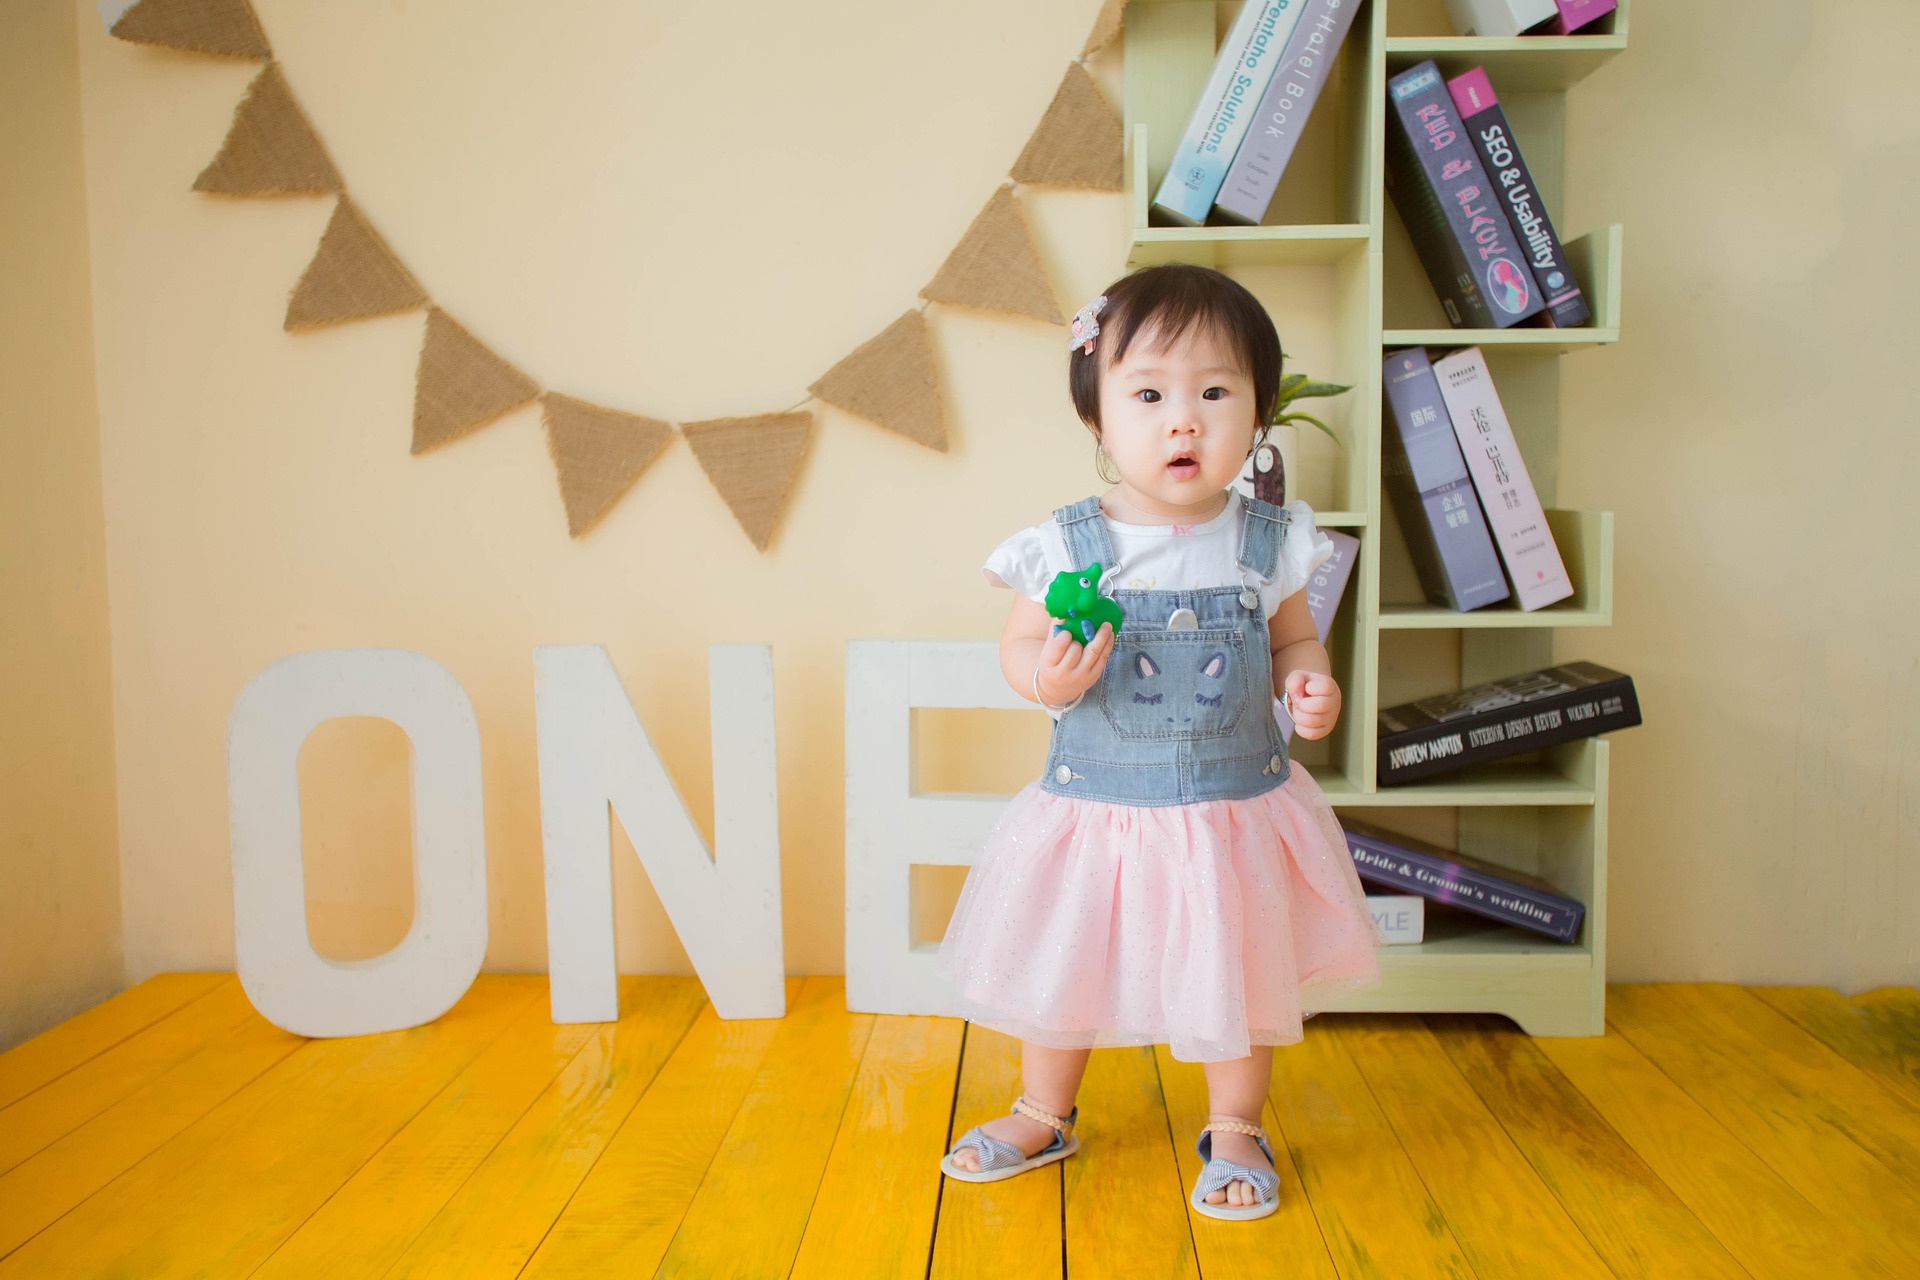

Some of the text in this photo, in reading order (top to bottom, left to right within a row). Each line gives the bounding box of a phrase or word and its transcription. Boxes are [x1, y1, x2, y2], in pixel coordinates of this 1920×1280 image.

[1205, 0, 1289, 154] Pentaho Solutions
[1294, 15, 1337, 80] Hotel
[1265, 81, 1305, 139] Book
[1416, 103, 1457, 151] RED
[1441, 159, 1472, 181] &
[1481, 124, 1557, 270] SEO & Usability
[1314, 551, 1342, 587] The
[1390, 741, 1428, 770] ANDREW
[1428, 733, 1463, 760] MARTIN
[1468, 723, 1505, 748] INTERIOR
[1505, 716, 1534, 739] DESIGN
[1534, 709, 1562, 732] REVIEW
[226, 640, 1043, 1038] ONE
[1354, 847, 1397, 871] Bride
[1398, 863, 1413, 877] &
[1490, 894, 1554, 924] wedding
